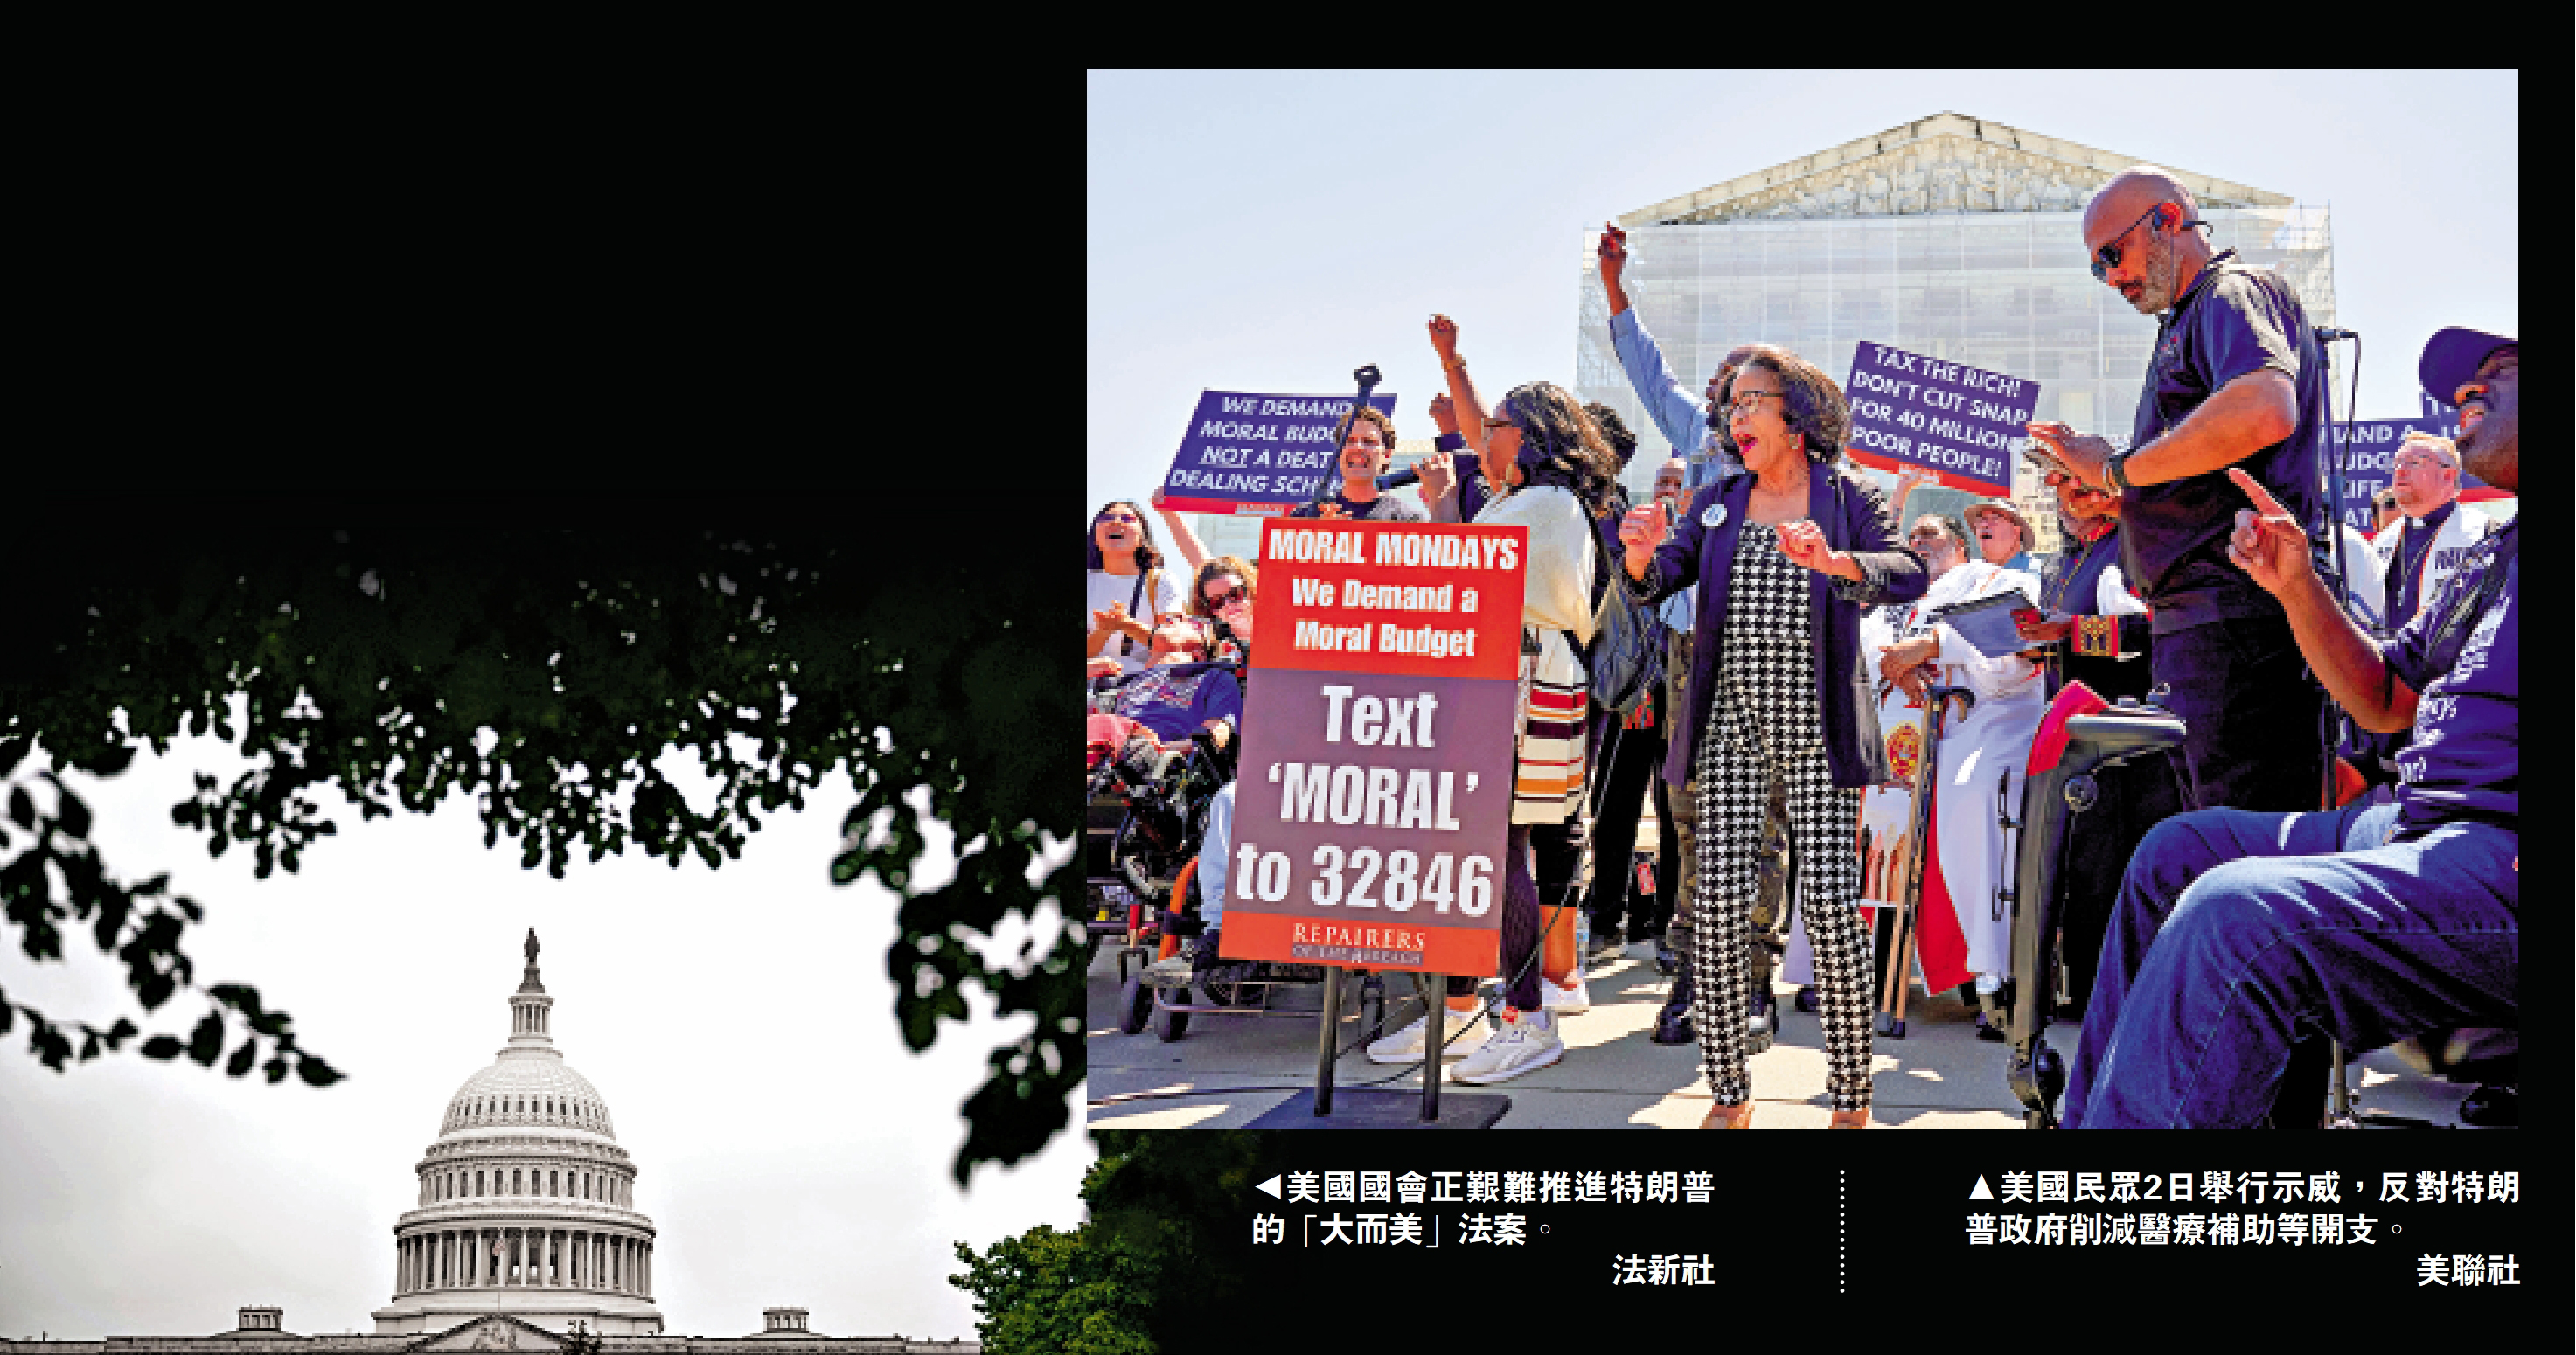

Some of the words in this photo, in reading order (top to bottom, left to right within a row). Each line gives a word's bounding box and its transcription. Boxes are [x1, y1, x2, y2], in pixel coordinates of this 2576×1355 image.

[1874, 346, 1918, 373] TAX
[1922, 358, 1959, 382] THE
[1962, 366, 2021, 398] RICH!
[1222, 396, 1258, 415] WE
[1259, 399, 1353, 417] DEMAND
[1849, 396, 1893, 422] FOR
[1896, 408, 1925, 431] 40
[1852, 369, 1920, 400] DON'T
[1923, 386, 1967, 412] CUT
[1968, 399, 2029, 426] SNAP
[1198, 420, 1278, 441] MORAL
[1198, 445, 1254, 466] NOT
[1253, 448, 1271, 466] A
[1274, 451, 1335, 469] DEAT
[1849, 427, 1912, 456] POOR
[1917, 442, 2002, 478] PEOPLE!
[1169, 469, 1270, 492] DEALING
[1268, 528, 1367, 564] MORAL
[1375, 532, 1519, 570] MONDAYS
[1292, 575, 1335, 607] We
[1341, 578, 1455, 613] Demand
[1459, 587, 1479, 613] a
[1293, 618, 1373, 652] Moral
[1378, 622, 1478, 659] Budget
[1320, 684, 1438, 748] Text
[1267, 761, 1479, 832] ‘MORAL’
[1236, 842, 1291, 903] to
[1310, 844, 1495, 918] 32846
[1292, 922, 1426, 951] REPAIRERS
